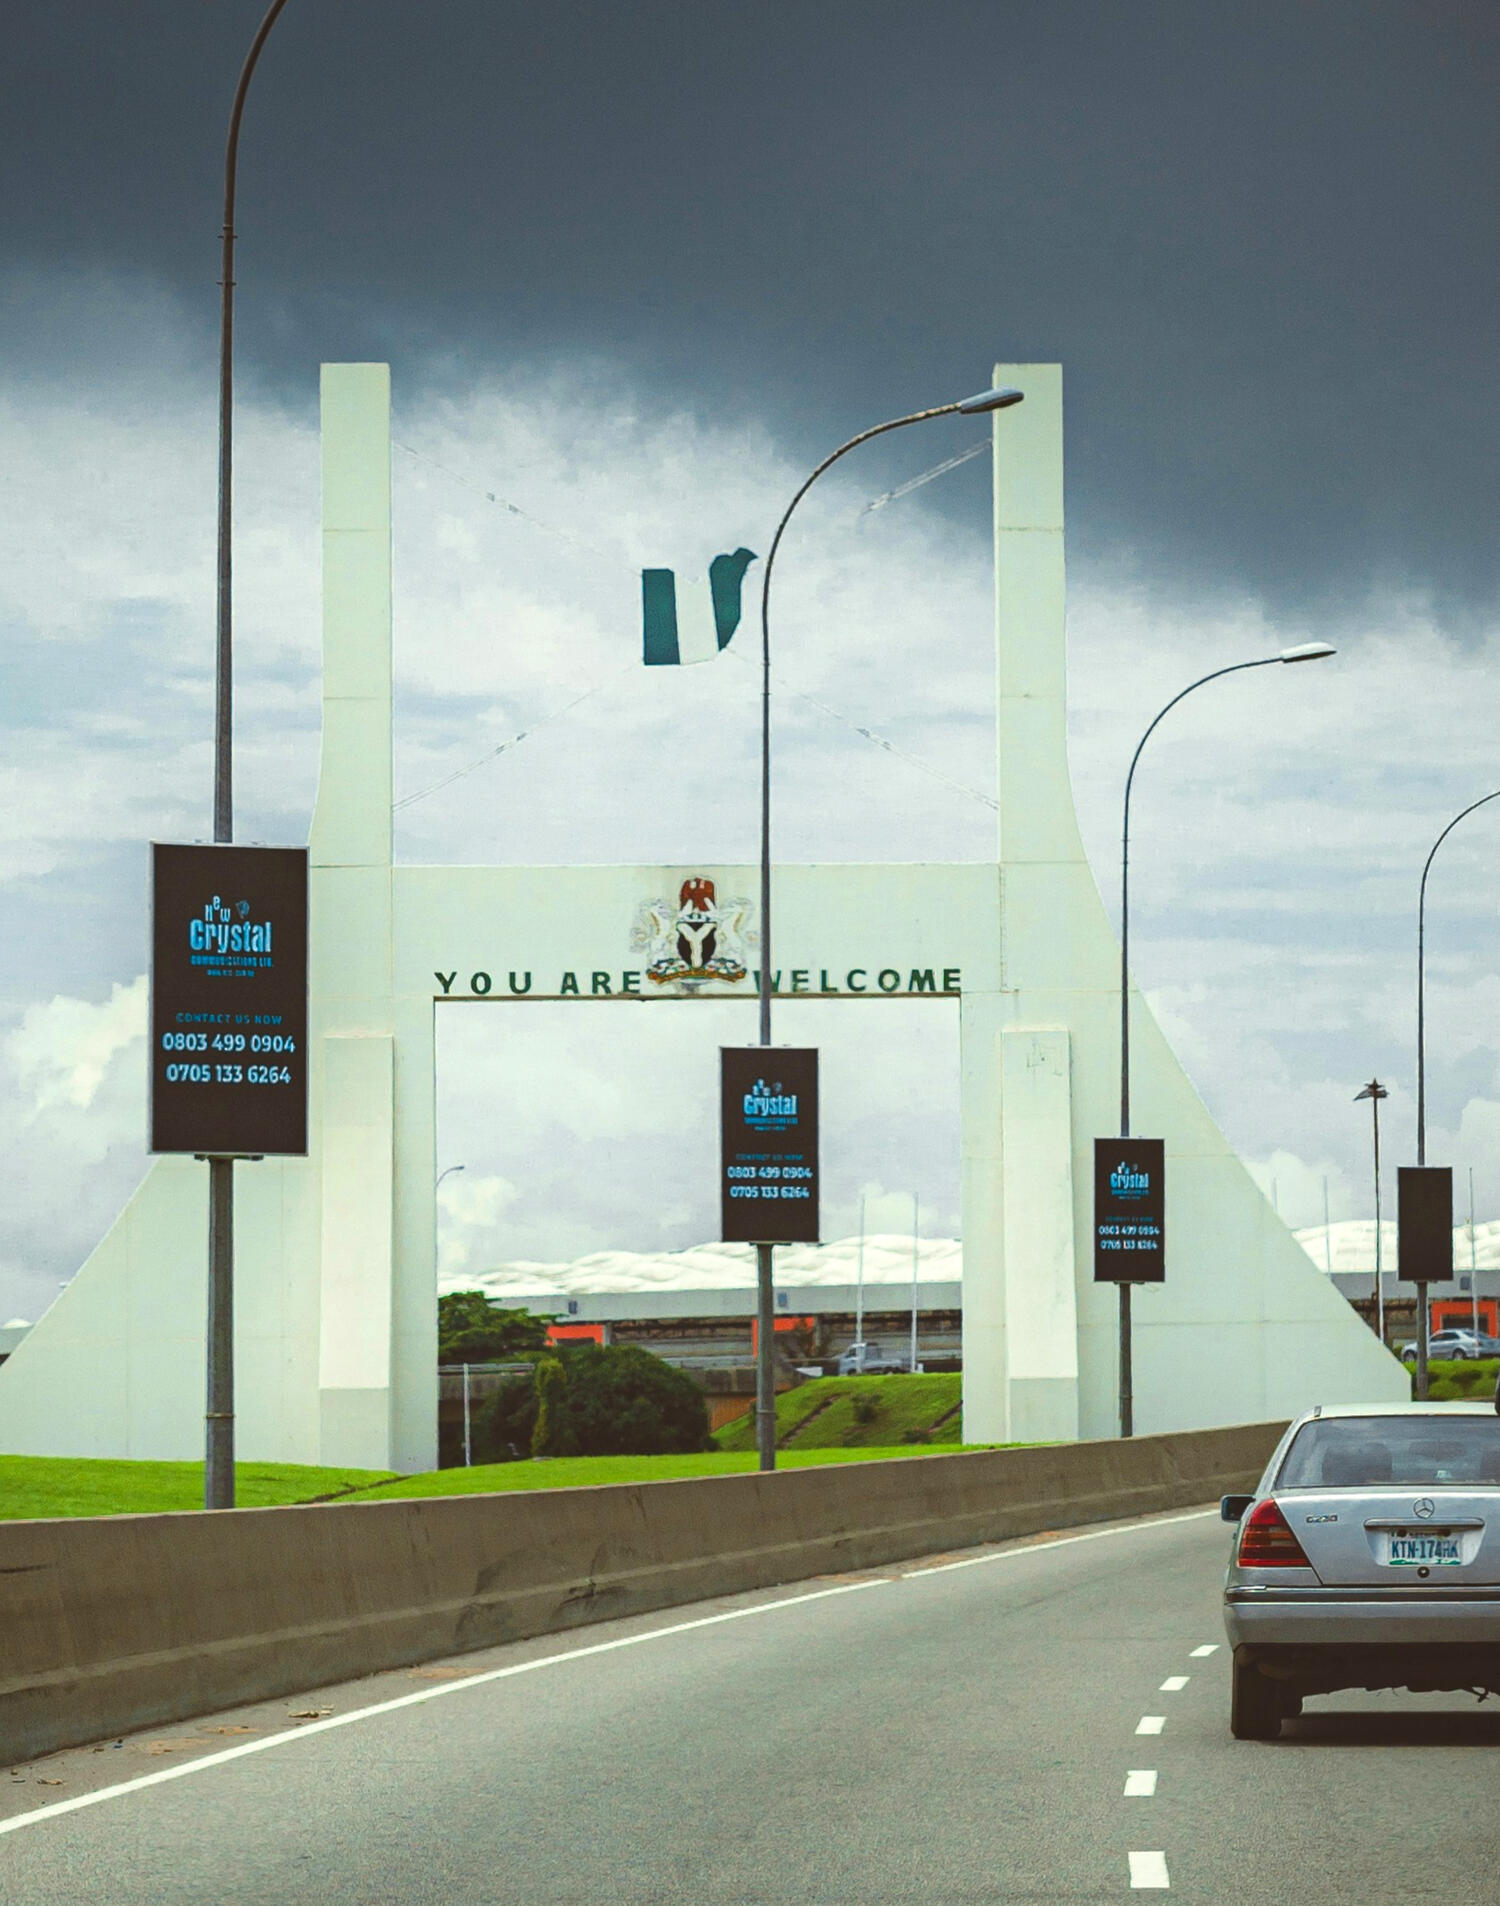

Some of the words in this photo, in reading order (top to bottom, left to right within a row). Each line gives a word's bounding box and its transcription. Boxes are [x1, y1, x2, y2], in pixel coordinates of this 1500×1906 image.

[190, 919, 272, 954] Crystal
[434, 971, 532, 995] YOU
[560, 971, 641, 995] ARE
[753, 969, 961, 993] WELCOME
[176, 1012, 231, 1024] CONTACT
[235, 1013, 250, 1024] US
[254, 1014, 283, 1025] NOW
[162, 1032, 208, 1051] 0803
[211, 1033, 246, 1052] 499
[250, 1034, 296, 1053] 0904
[166, 1063, 212, 1083] 0705
[215, 1064, 243, 1083] 133
[247, 1065, 292, 1084] 6264
[743, 1094, 798, 1116] Crystal
